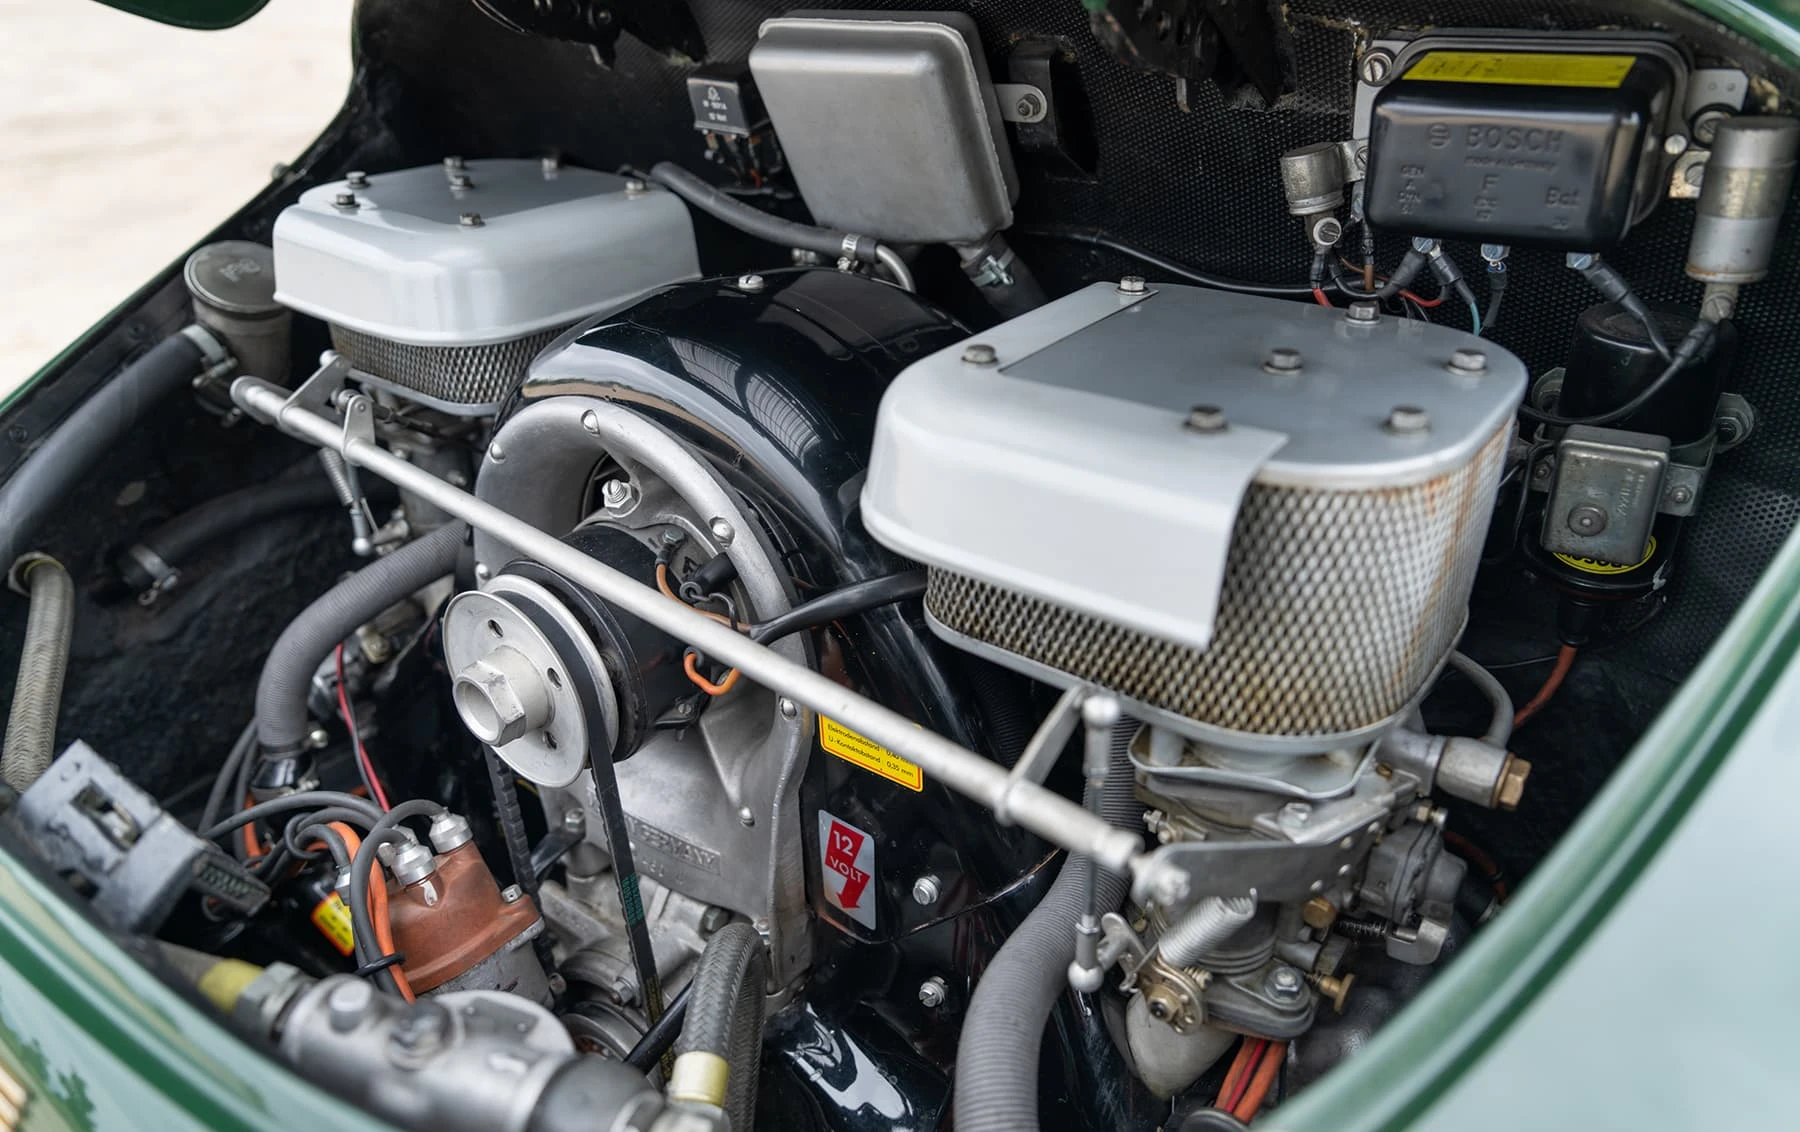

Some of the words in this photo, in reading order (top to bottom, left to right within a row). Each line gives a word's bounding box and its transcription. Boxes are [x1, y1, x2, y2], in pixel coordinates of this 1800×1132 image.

[1465, 124, 1565, 152] BOSCH
[833, 829, 854, 857] 12
[830, 855, 863, 884] VOLT
